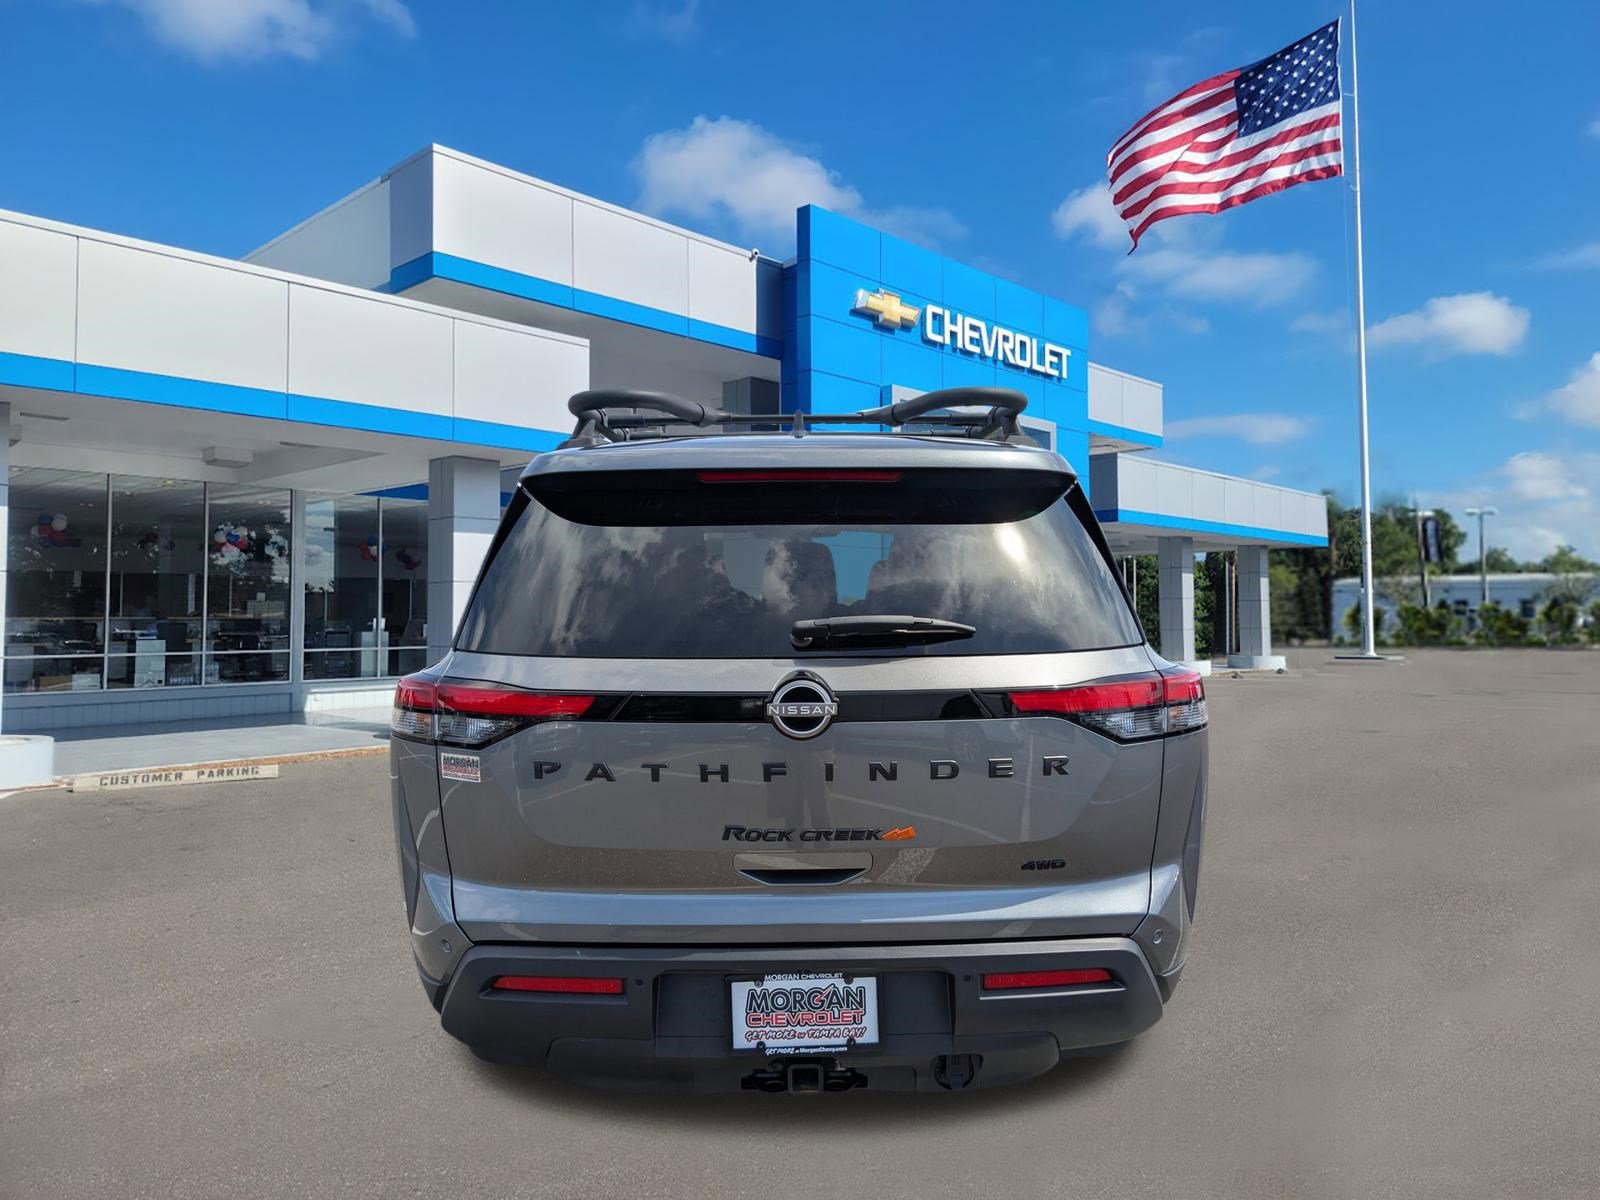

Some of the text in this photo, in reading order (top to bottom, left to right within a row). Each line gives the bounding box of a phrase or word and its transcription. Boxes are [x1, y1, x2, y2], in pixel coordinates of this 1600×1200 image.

[925, 303, 1072, 379] CHEVROLET
[768, 705, 836, 715] NISSAN
[100, 766, 260, 786] CUSTOMER PARKING
[532, 755, 1070, 783] PATHFINDER
[722, 824, 884, 842] ROCK CREEK
[1021, 859, 1066, 870] 4WD
[765, 973, 799, 981] MORGAN
[746, 984, 865, 1012] MORGAN
[747, 1010, 865, 1026] CHEVROLET
[745, 1030, 766, 1042] GET
[766, 1029, 796, 1040] MORE
[807, 1028, 841, 1039] TAMPA
[799, 1046, 848, 1054] MorganChevy.com
